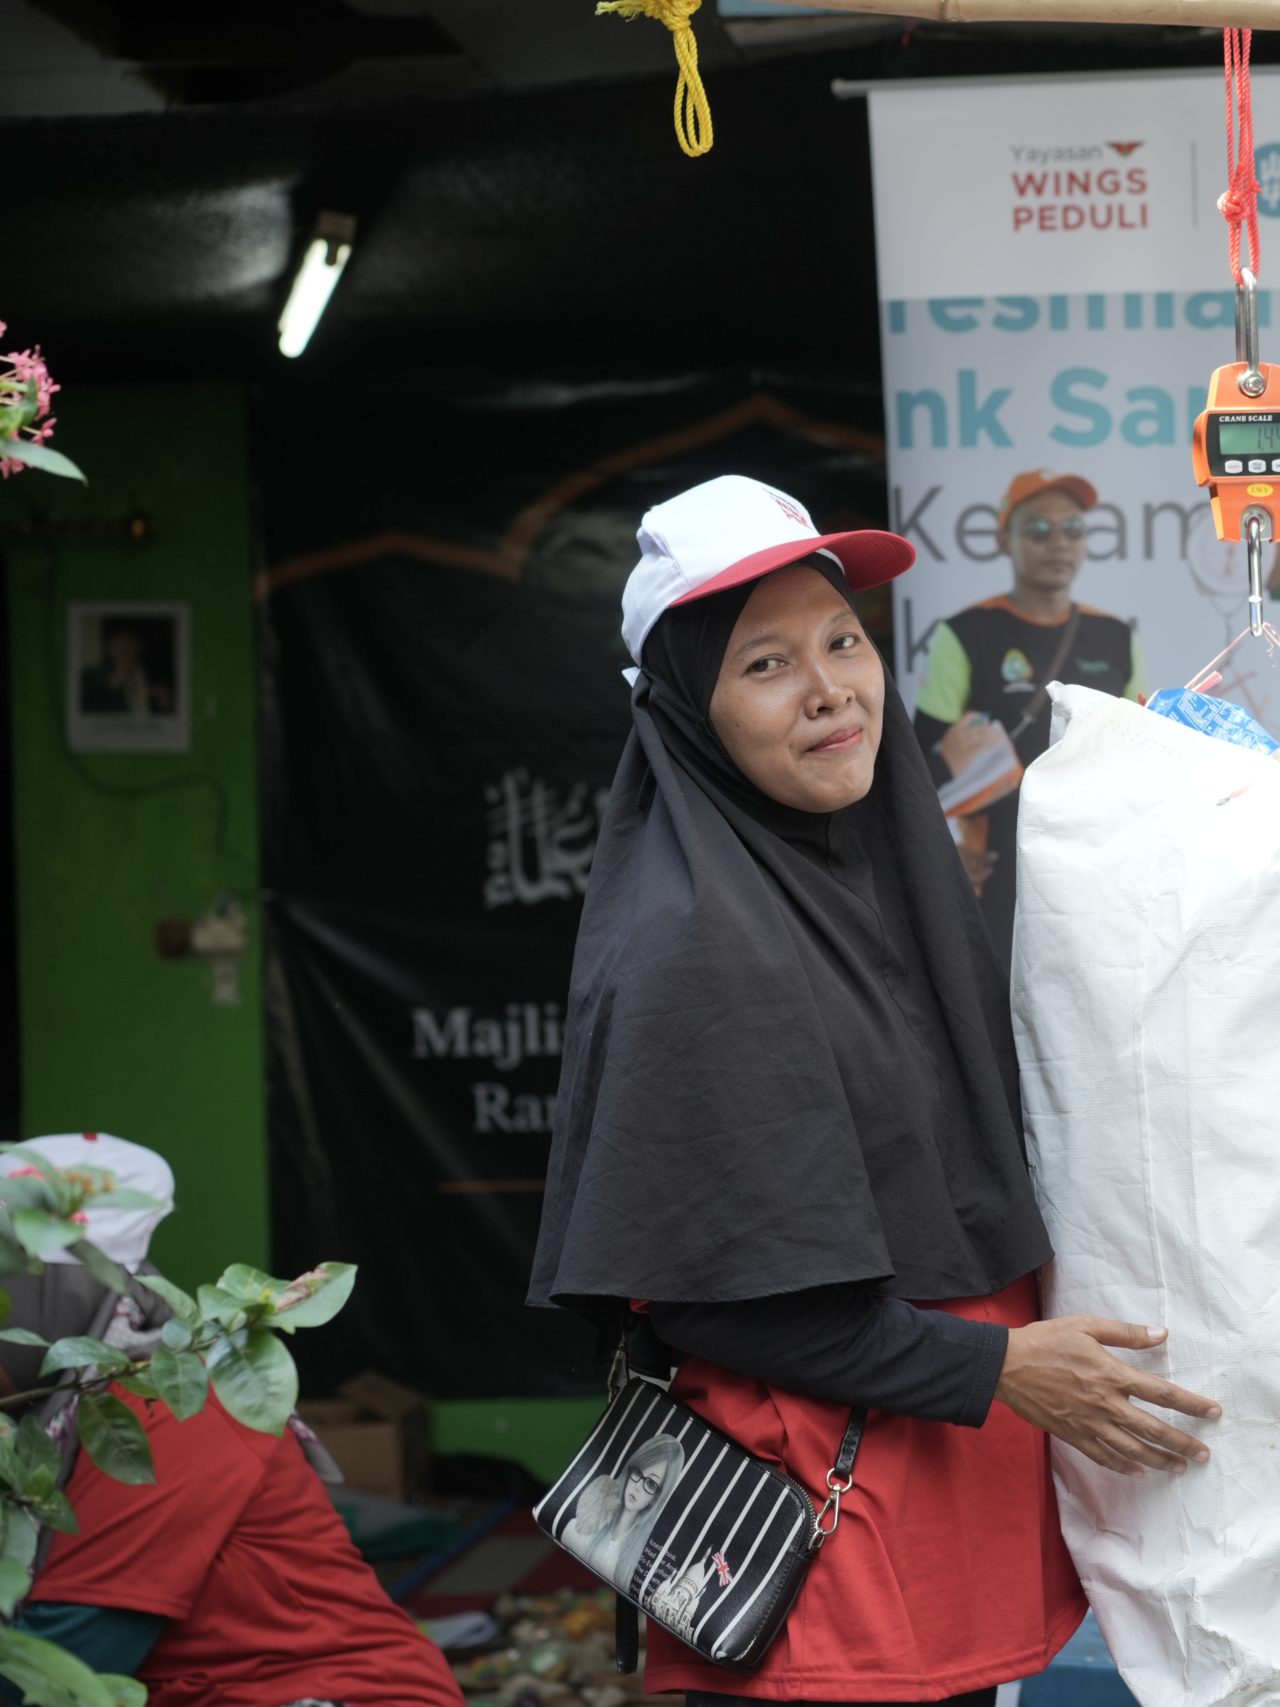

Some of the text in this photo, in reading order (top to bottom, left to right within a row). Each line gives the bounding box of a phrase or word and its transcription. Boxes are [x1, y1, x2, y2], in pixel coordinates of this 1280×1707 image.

[1010, 144, 1104, 164] Yayasan
[1011, 168, 1148, 198] WINGS
[1012, 202, 1149, 232] PEDULI
[1219, 414, 1273, 423] CRANE SCALE
[413, 1002, 566, 1070] Majli
